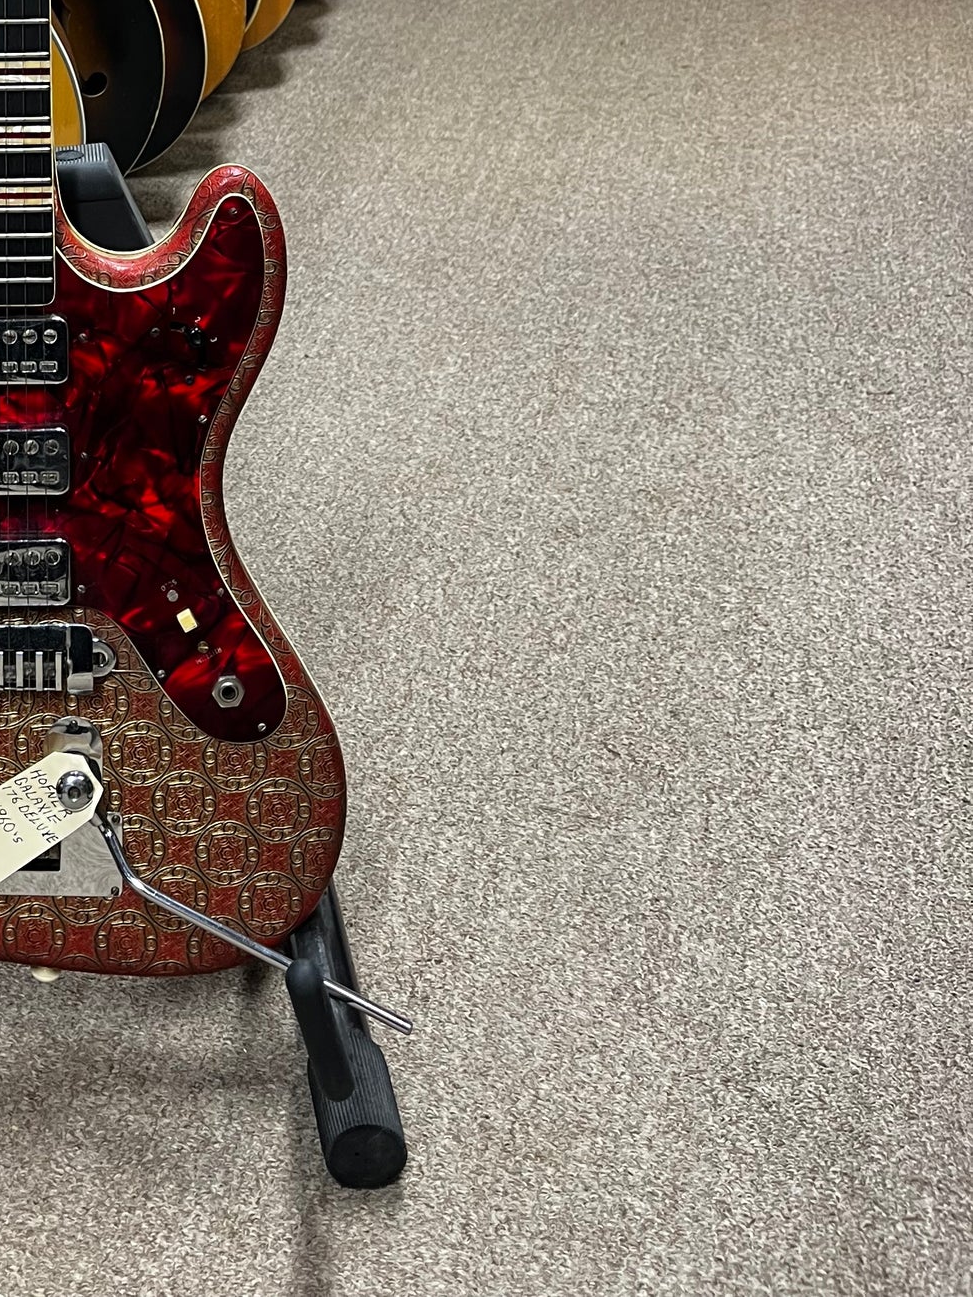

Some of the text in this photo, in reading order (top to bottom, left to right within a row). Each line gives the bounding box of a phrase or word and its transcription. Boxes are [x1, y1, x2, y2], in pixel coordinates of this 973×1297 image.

[2, 785, 59, 844] 176 DELUXE
[14, 777, 62, 824] GALAXIE
